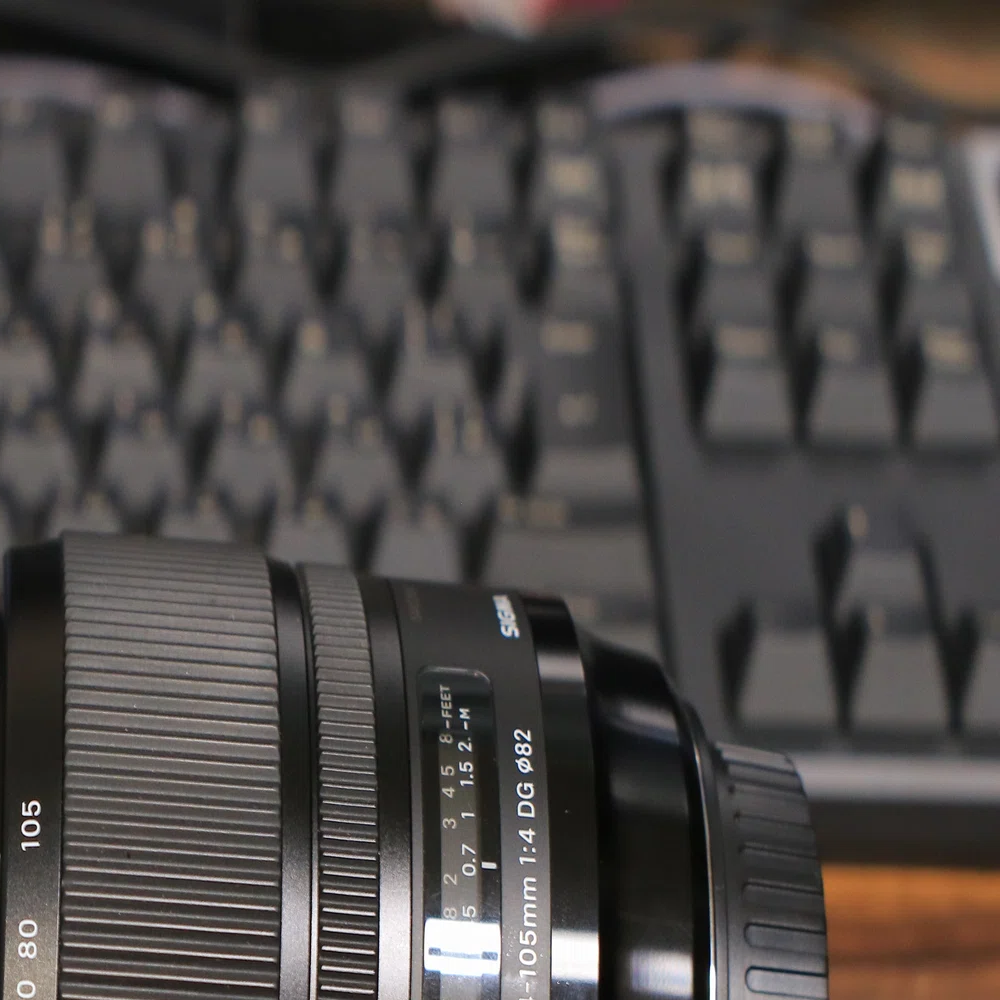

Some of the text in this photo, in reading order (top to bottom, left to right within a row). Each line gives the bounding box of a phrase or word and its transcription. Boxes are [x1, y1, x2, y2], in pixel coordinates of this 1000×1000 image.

[439, 733, 453, 744] 8
[440, 765, 455, 777] 5
[459, 761, 474, 787] 1.5
[441, 786, 455, 799] 4
[516, 781, 535, 818] DG
[442, 818, 456, 829] 3
[461, 811, 475, 820] 1
[21, 800, 42, 851] 105
[518, 828, 536, 865] 1:4
[461, 843, 476, 876] 0.7
[443, 873, 457, 885] 2
[18, 919, 38, 959] 80
